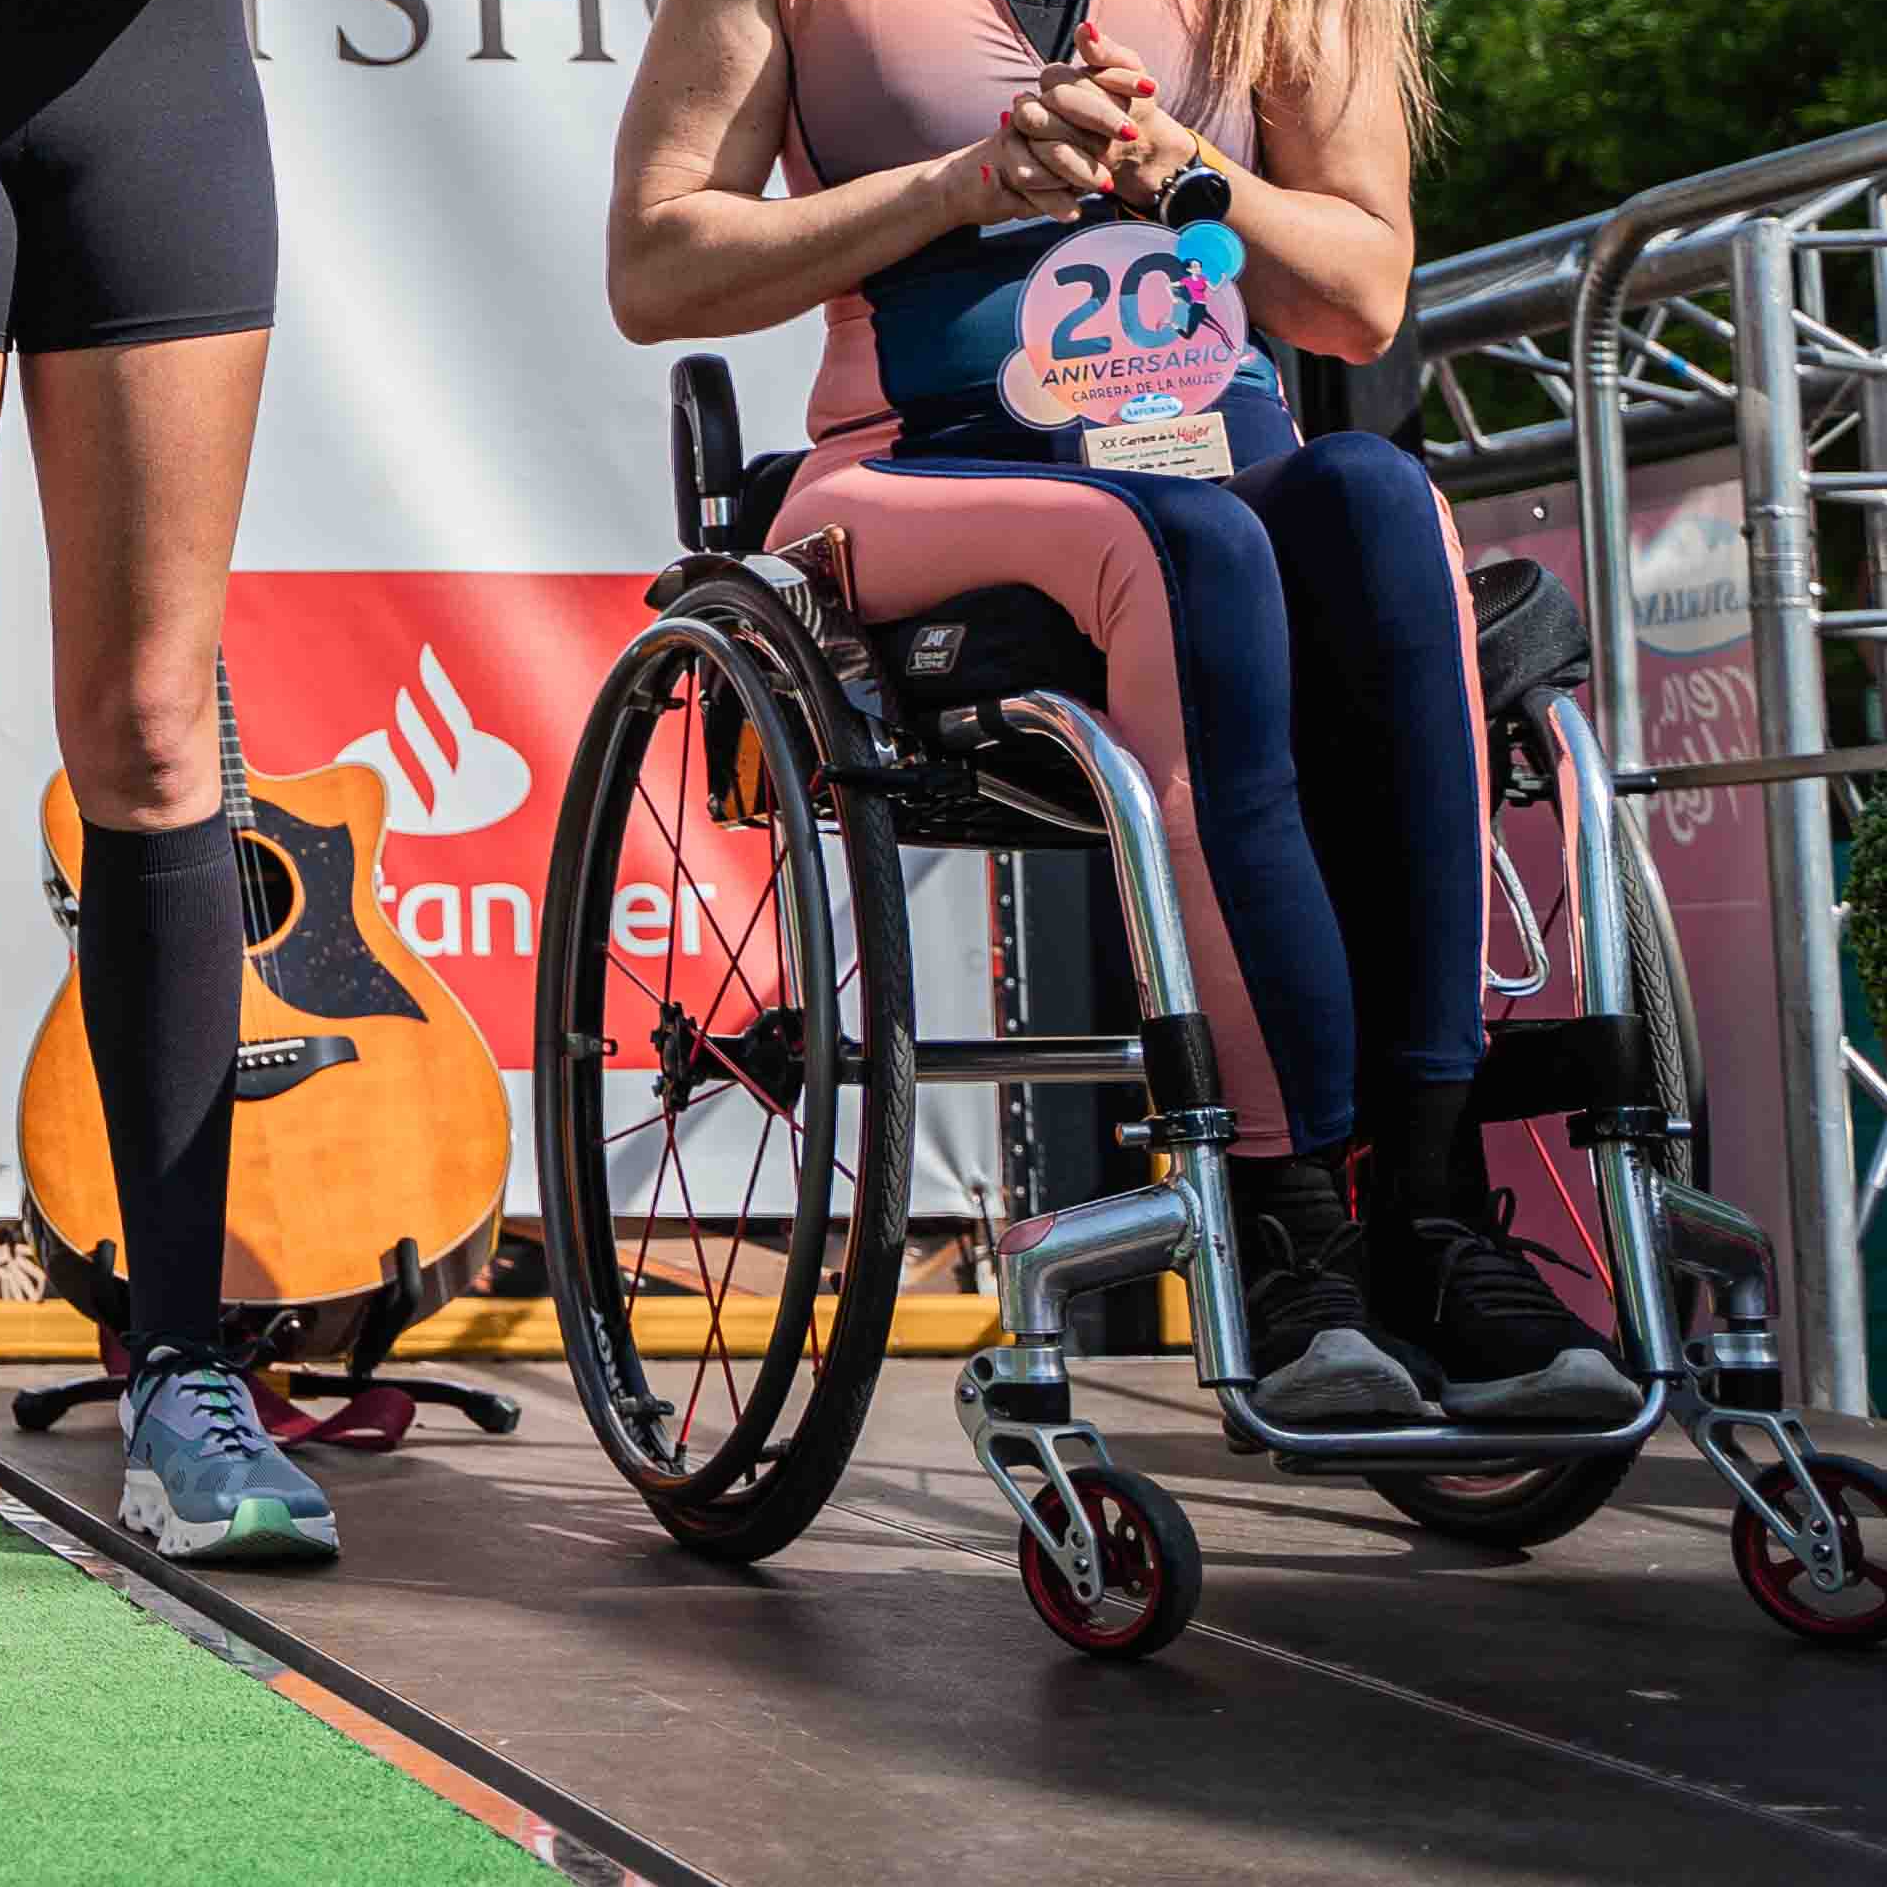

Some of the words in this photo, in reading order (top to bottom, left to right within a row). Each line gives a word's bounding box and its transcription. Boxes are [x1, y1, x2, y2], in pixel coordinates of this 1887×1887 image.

[1051, 252, 1190, 361] 20
[1041, 344, 1233, 388] ANIVERSARIO
[1072, 384, 1130, 403] CARRERA
[1136, 382, 1154, 396] DE
[1158, 379, 1175, 392] LA
[1179, 372, 1225, 388] MUJER
[1099, 440, 1117, 450] XX
[1176, 425, 1211, 444] Mujer
